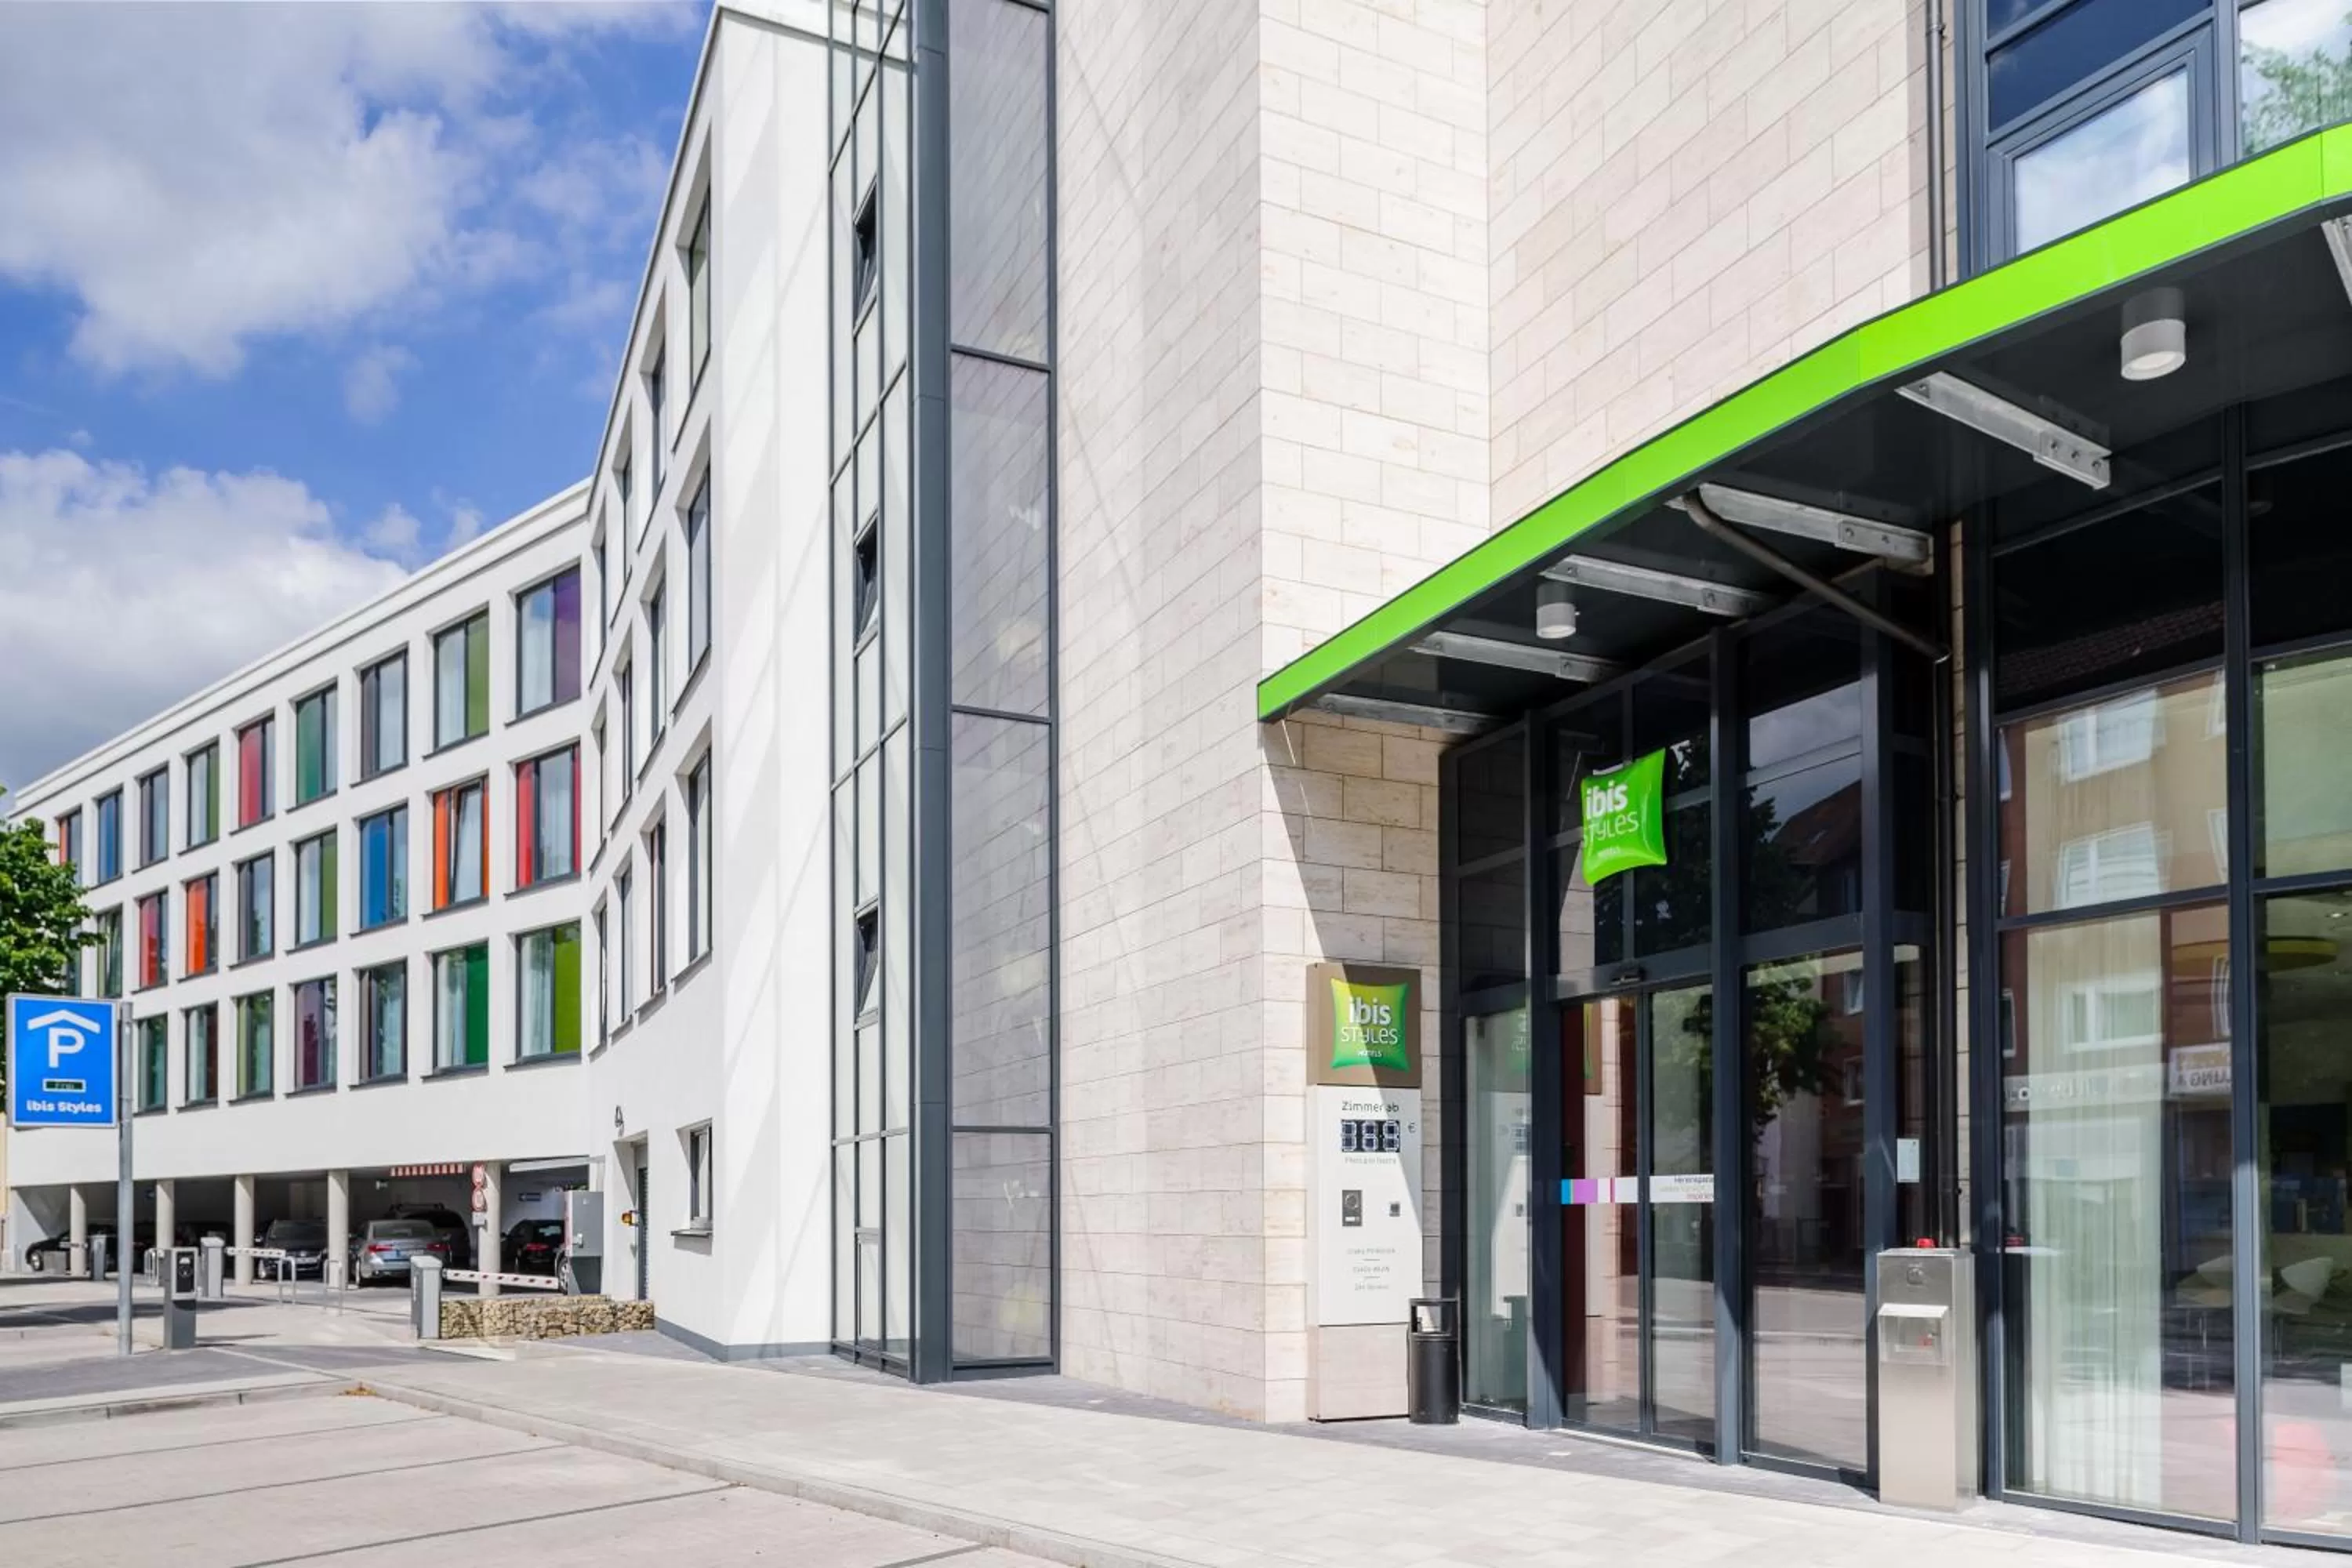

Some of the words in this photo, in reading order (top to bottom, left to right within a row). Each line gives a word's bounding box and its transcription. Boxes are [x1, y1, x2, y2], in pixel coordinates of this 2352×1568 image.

[1586, 779, 1628, 819] ibis
[1349, 996, 1392, 1025] ibis
[48, 1027, 86, 1069] P
[57, 1101, 102, 1114] Styles
[1341, 1101, 1384, 1112] Zimmer
[1385, 1102, 1399, 1112] ab
